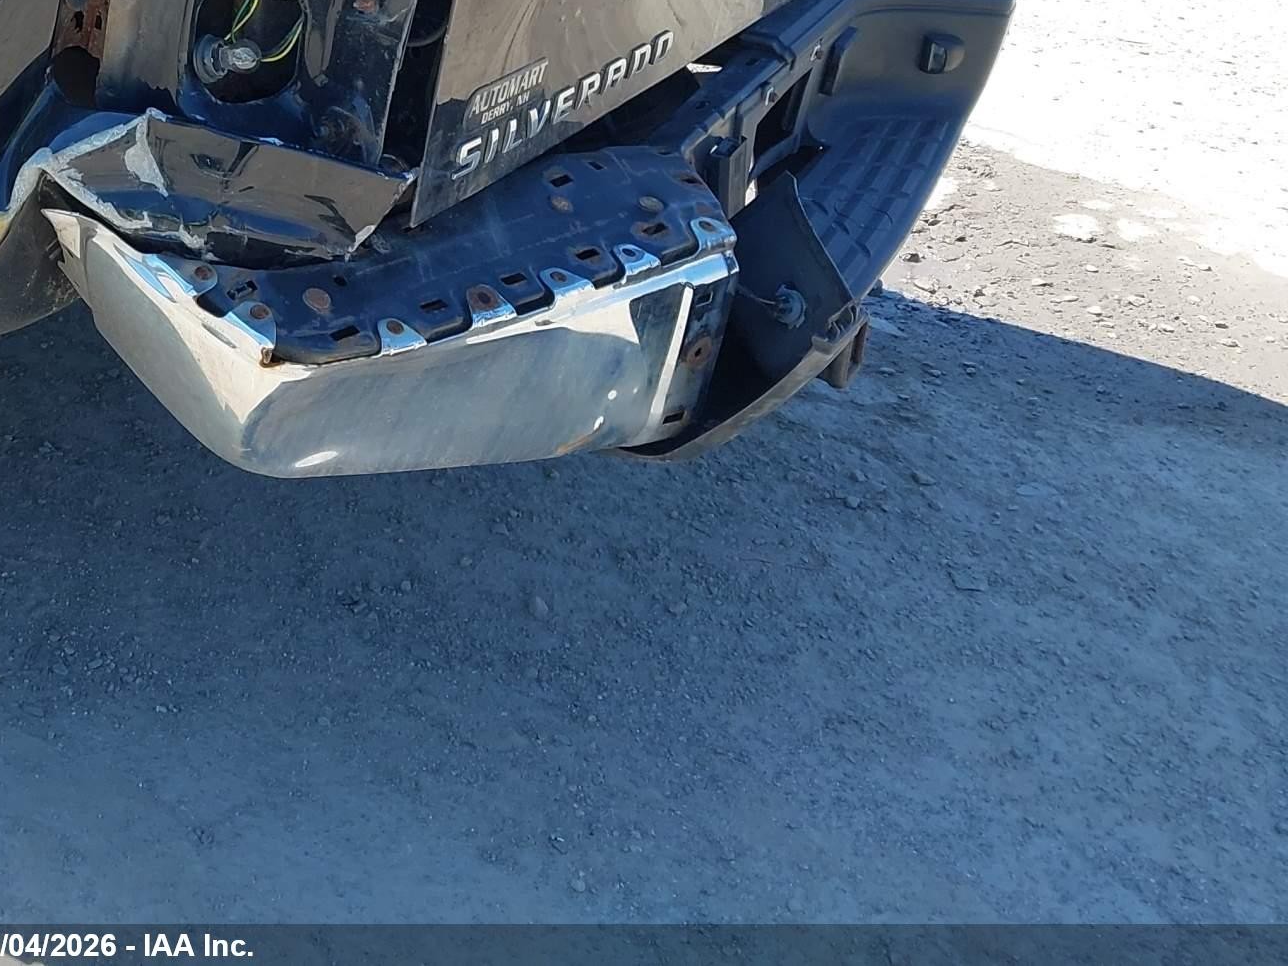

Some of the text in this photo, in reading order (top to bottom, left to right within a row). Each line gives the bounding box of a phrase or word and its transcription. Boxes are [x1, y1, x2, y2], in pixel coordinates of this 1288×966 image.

[451, 29, 675, 180] SILVERADO
[469, 60, 549, 119] AUTOMART
[480, 91, 531, 125] DERRY, NH
